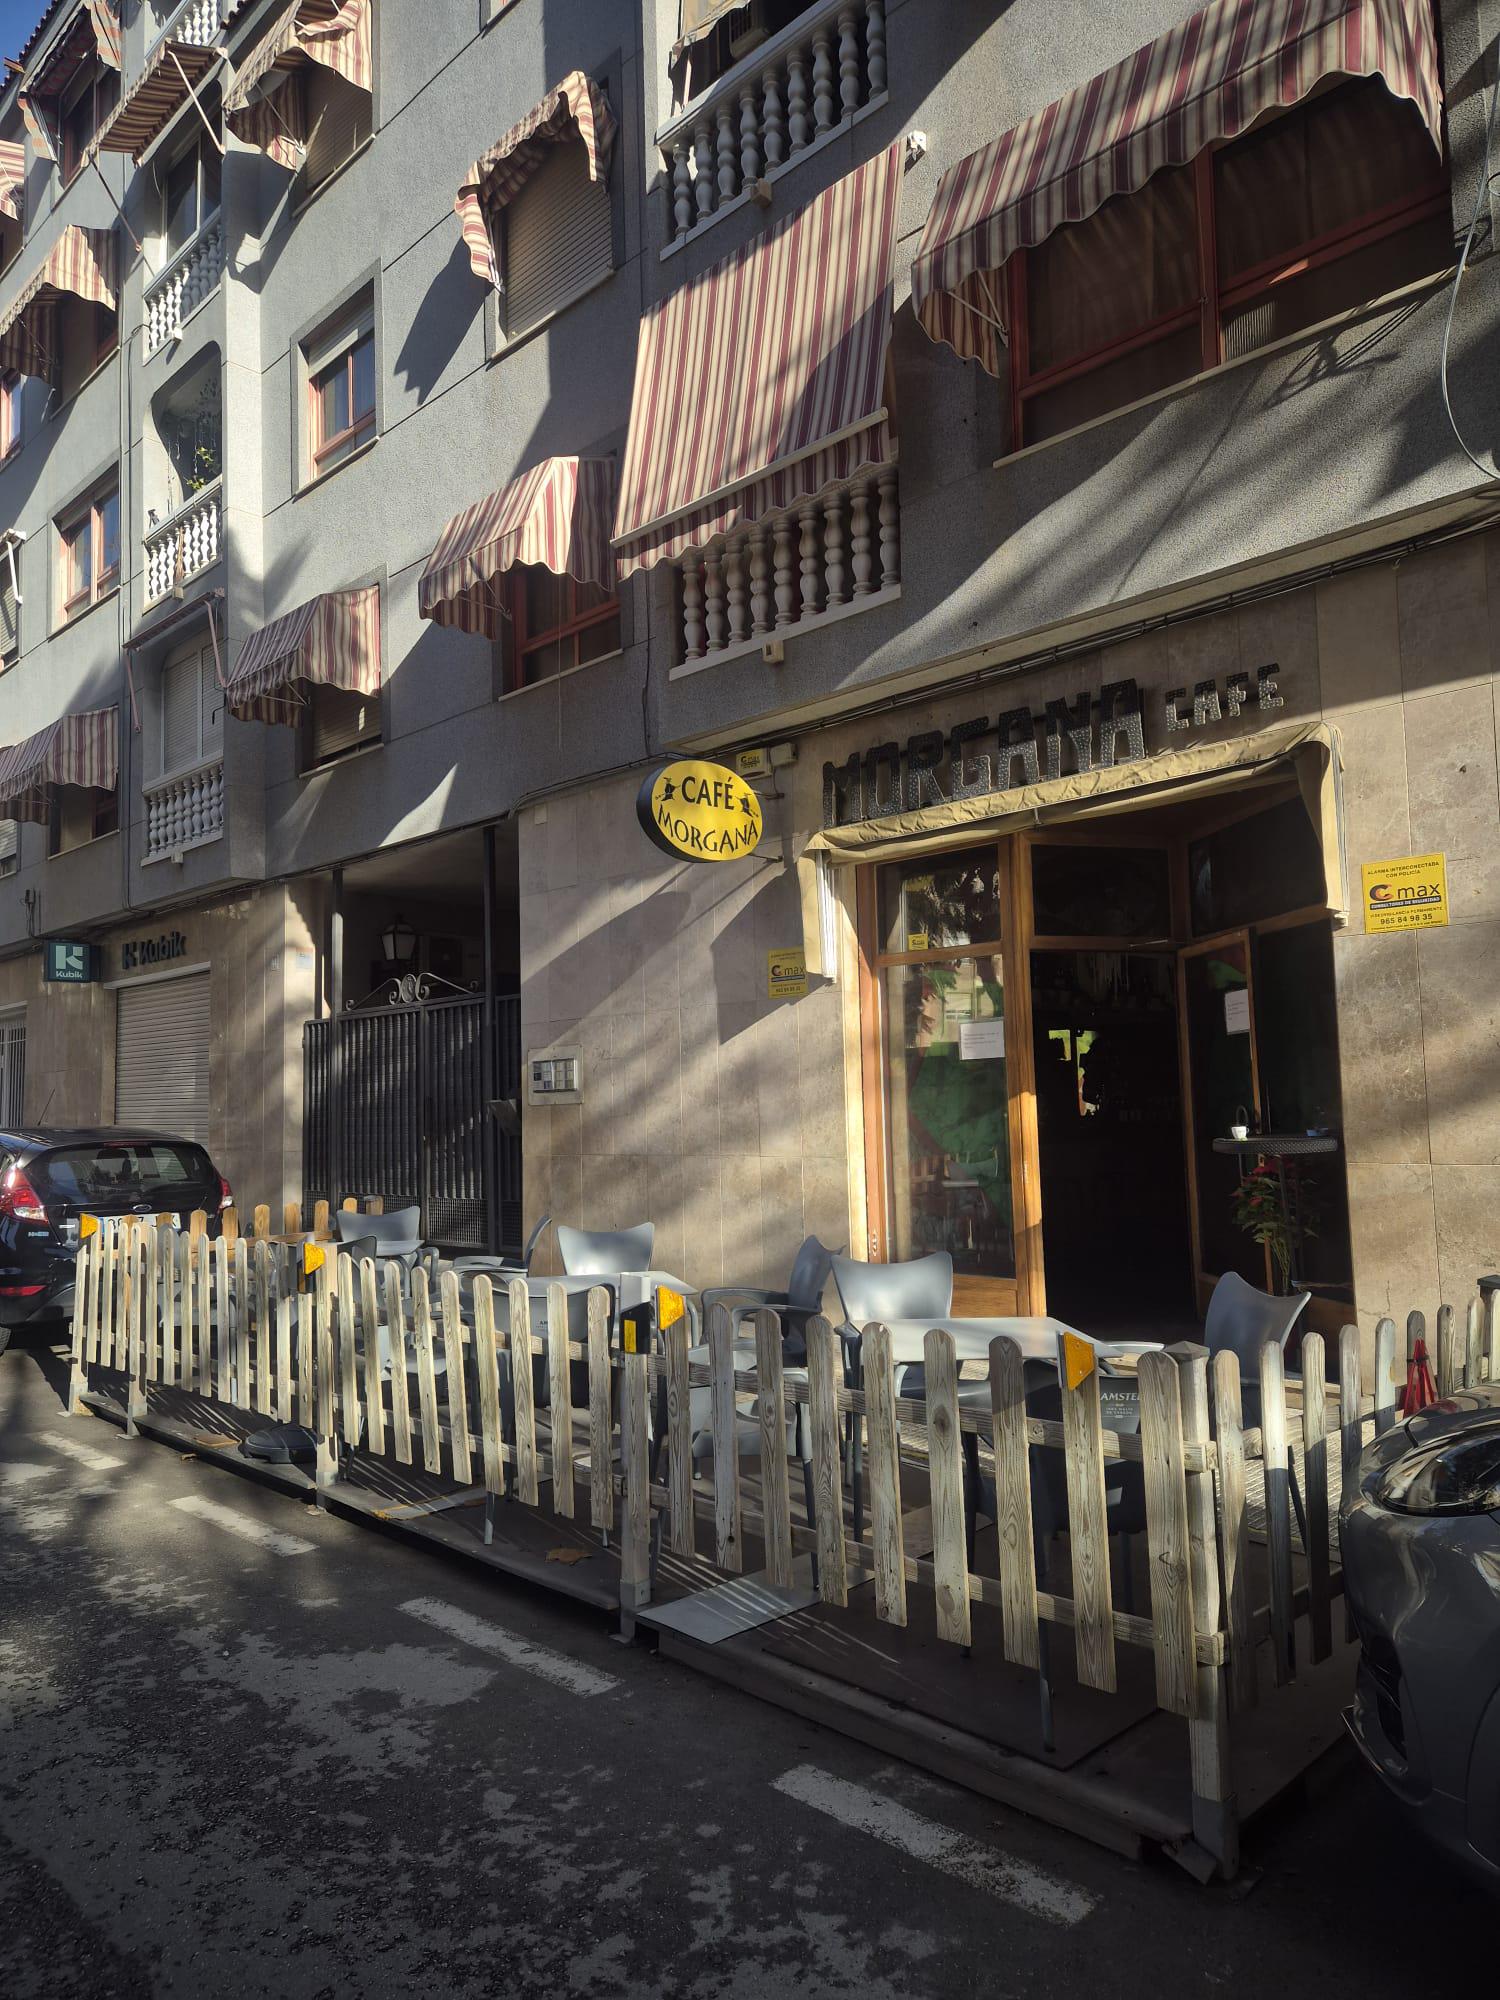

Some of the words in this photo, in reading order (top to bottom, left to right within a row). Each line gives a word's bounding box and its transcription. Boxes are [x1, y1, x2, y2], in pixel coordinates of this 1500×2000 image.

[823, 677, 1146, 828] MORGANA
[1165, 663, 1287, 731] CAFE
[681, 776, 735, 810] CAFÉ
[658, 804, 759, 855] MORGANA
[1390, 862, 1439, 871] INTERCONECTADA
[1380, 917, 1395, 925] 965
[139, 931, 187, 965] Kubik
[56, 970, 83, 978] Kubik
